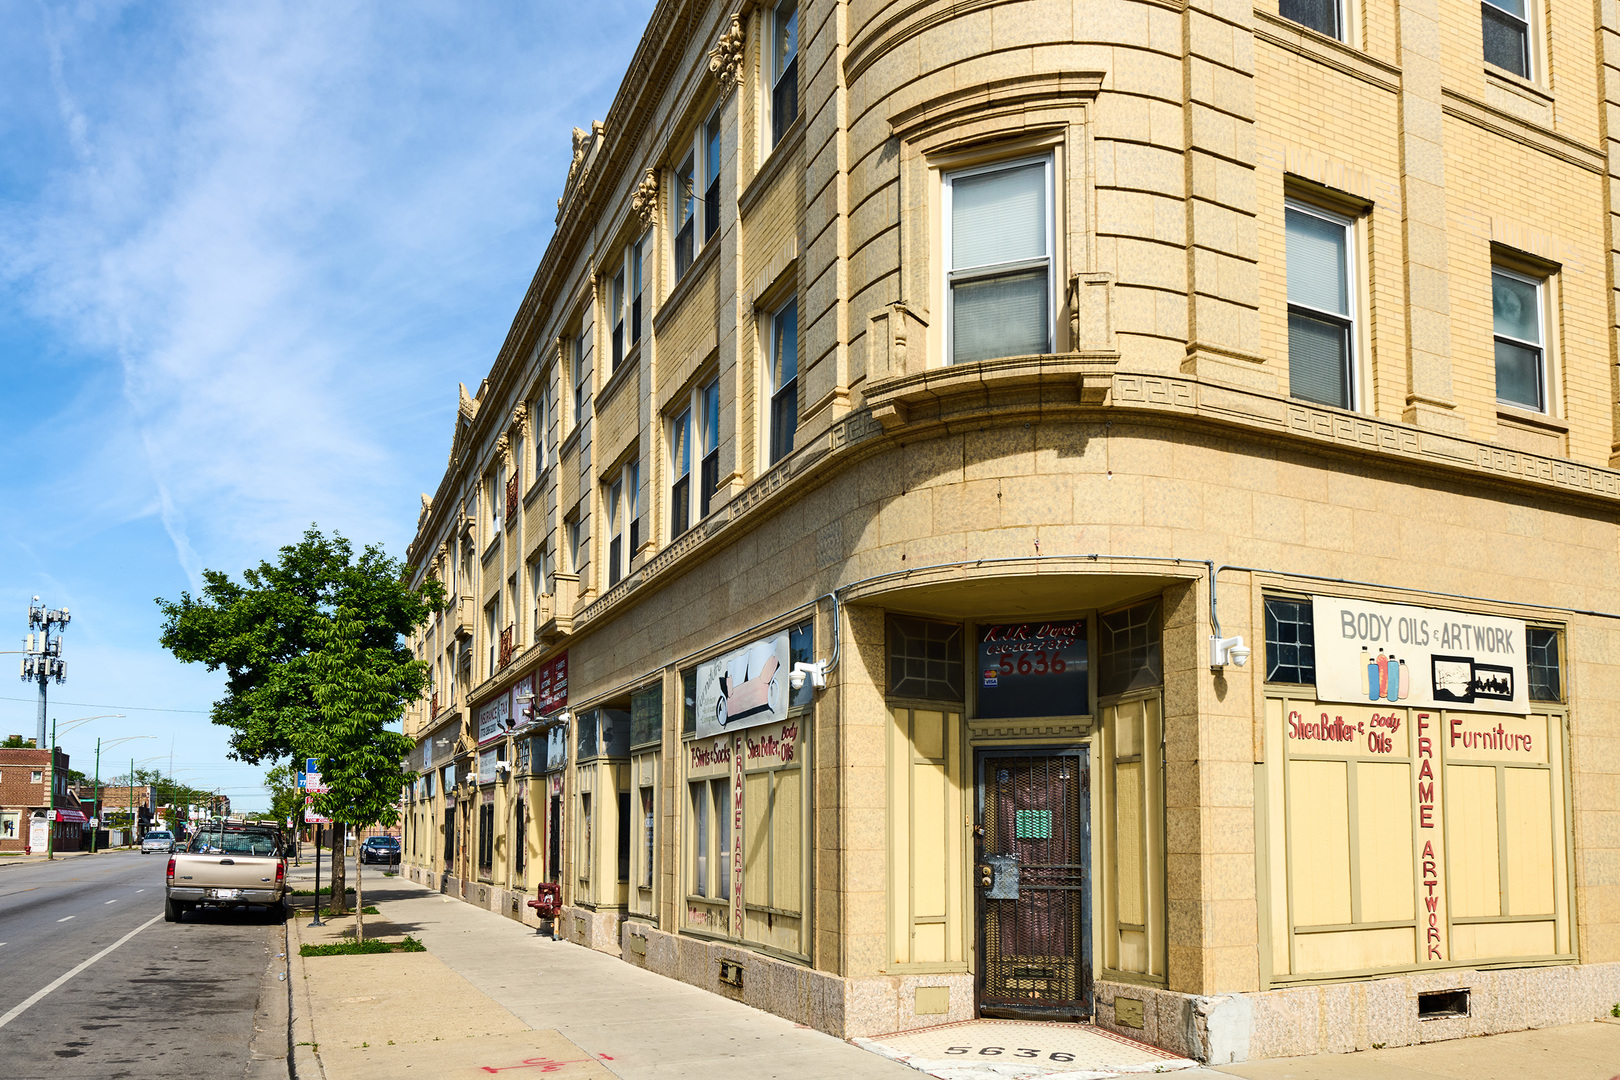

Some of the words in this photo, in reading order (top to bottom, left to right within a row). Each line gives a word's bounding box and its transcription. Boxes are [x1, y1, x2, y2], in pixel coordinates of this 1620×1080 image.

[1036, 622, 1083, 639] Depot
[1340, 610, 1392, 642] BODY
[1399, 617, 1430, 646] OILS
[1441, 622, 1515, 654] ARTWORK
[999, 650, 1066, 676] 5636
[781, 722, 798, 742] Body
[1370, 713, 1400, 733] Body
[1450, 719, 1532, 751] Furniture
[781, 743, 794, 762] Oils
[1368, 731, 1393, 753] Oils
[691, 746, 710, 769] T-Shirts
[714, 743, 731, 765] Socks
[1418, 713, 1435, 828] FRAME
[734, 836, 742, 935] ARTWORK
[1422, 840, 1442, 960] ARTWORK
[943, 1046, 1077, 1062] 5636
